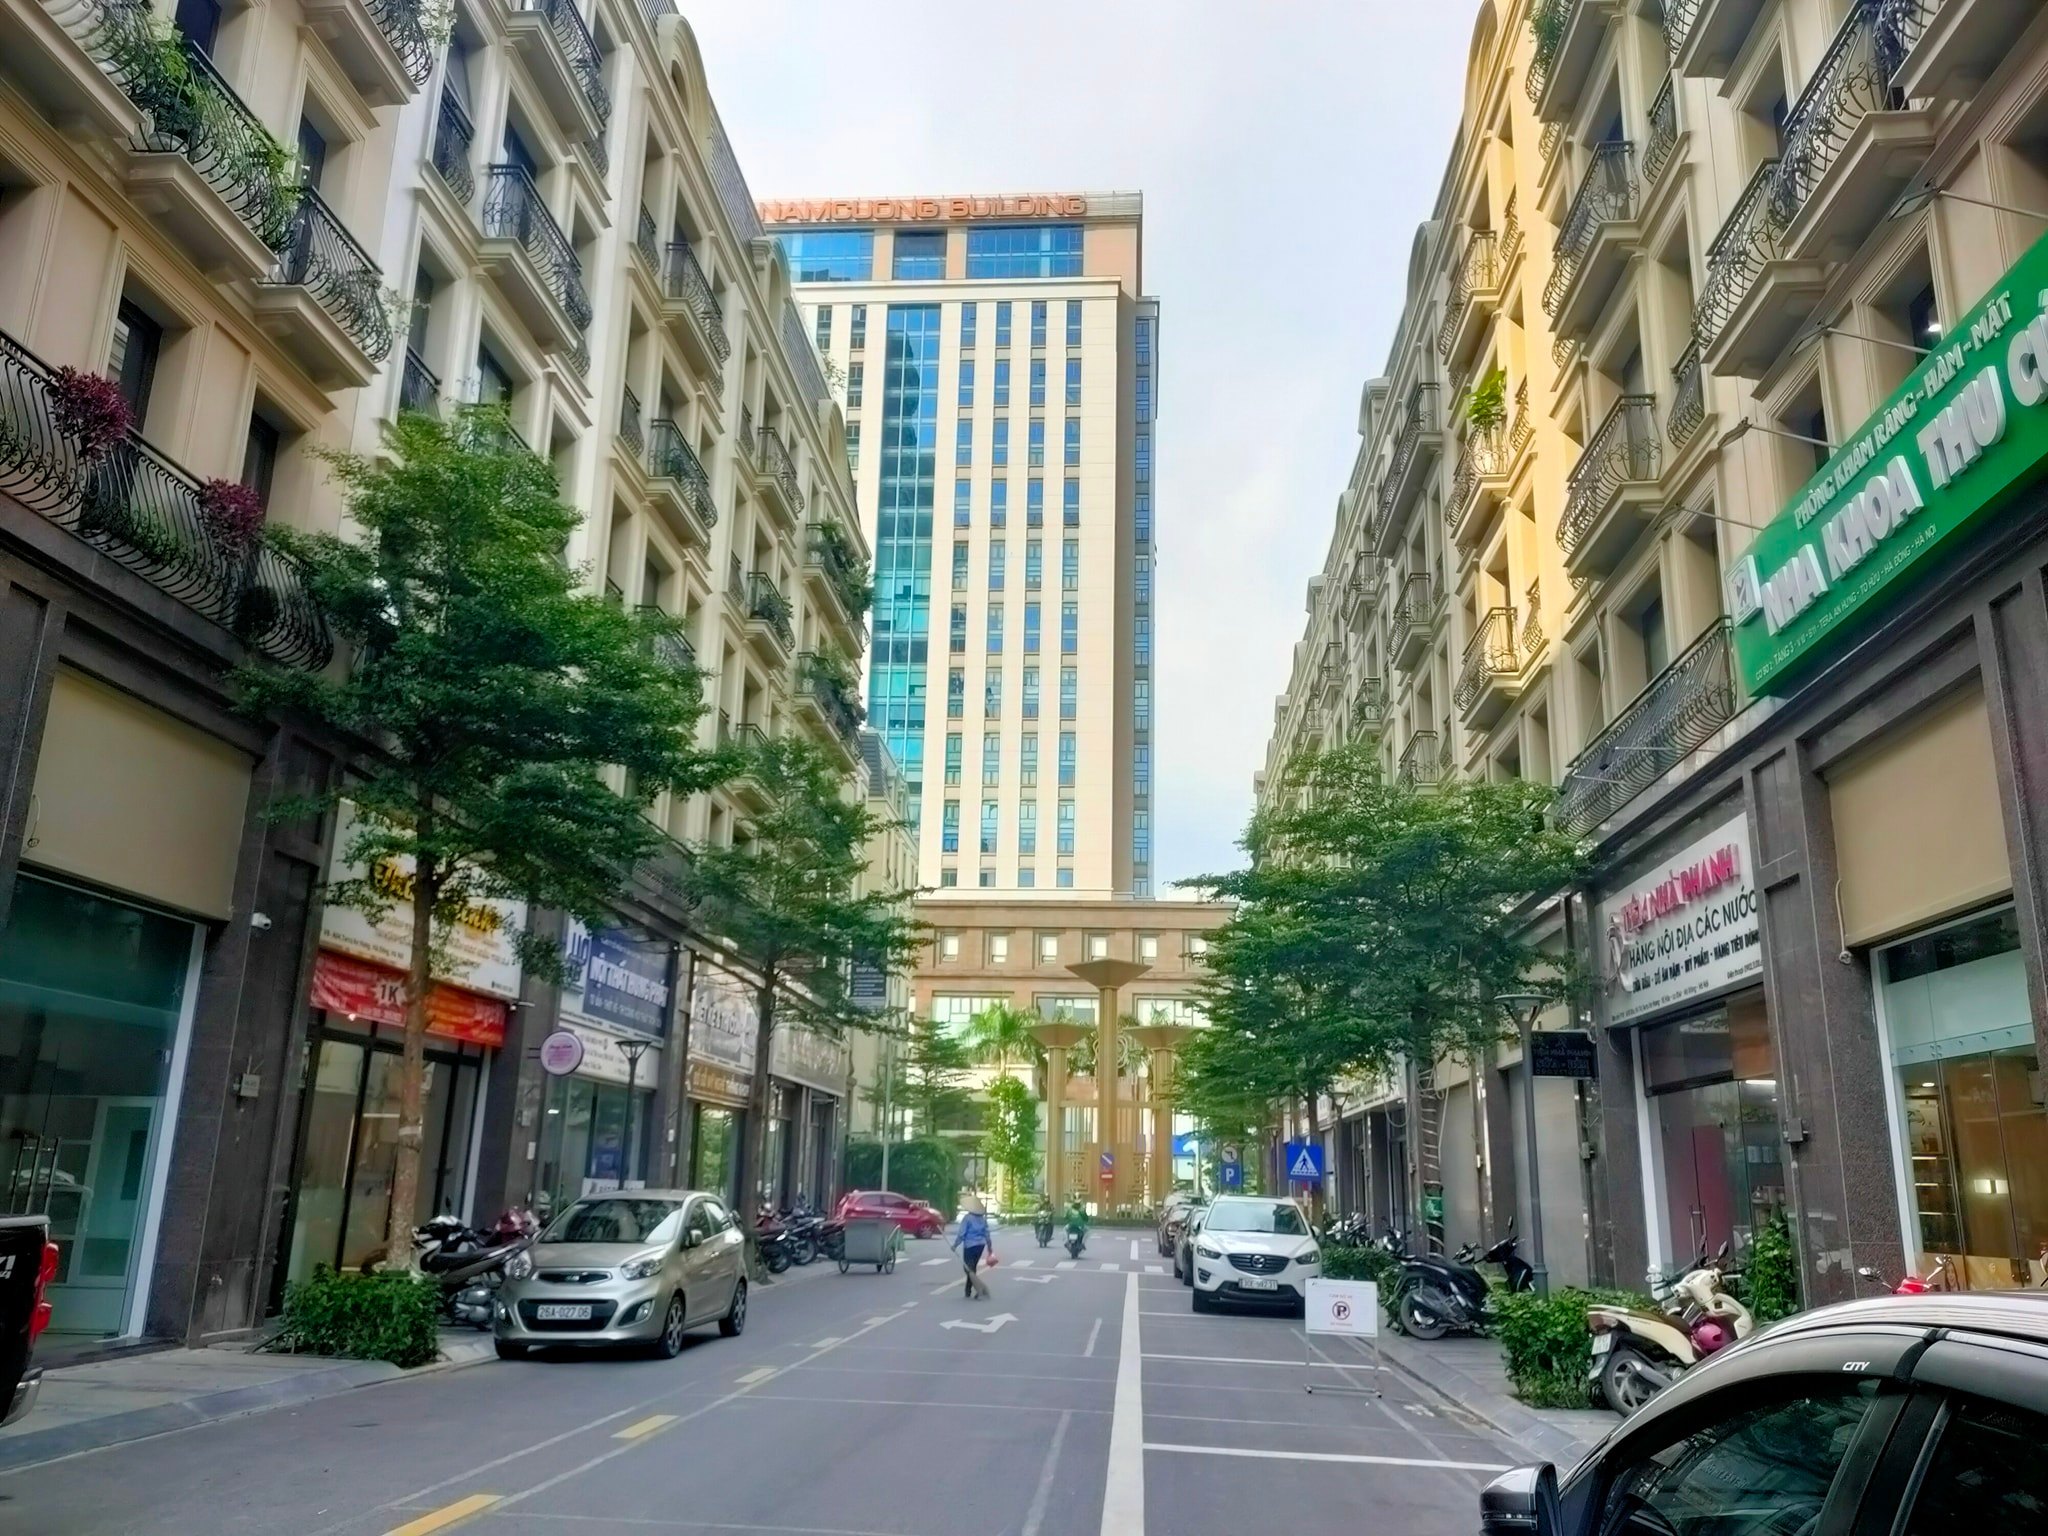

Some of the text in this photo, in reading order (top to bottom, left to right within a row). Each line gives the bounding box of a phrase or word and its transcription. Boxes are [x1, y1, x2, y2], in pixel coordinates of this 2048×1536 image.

[948, 194, 1087, 218] BUILDING
[1833, 437, 1877, 491] KHÁM
[1872, 392, 1918, 451] RĂNG
[1970, 290, 2013, 351] MẶT
[1760, 544, 1829, 638] NHA
[1821, 455, 1925, 582] KHOA
[1916, 365, 2007, 491] THU
[1628, 940, 1656, 968] HÀNG
[1657, 928, 1674, 960] NỘI
[1676, 923, 1695, 951] ĐỊA
[1695, 906, 1721, 939] CÁC
[380, 983, 399, 1003] 1K
[1225, 1168, 1235, 1182] P
[1842, 1361, 1870, 1371] CITY
